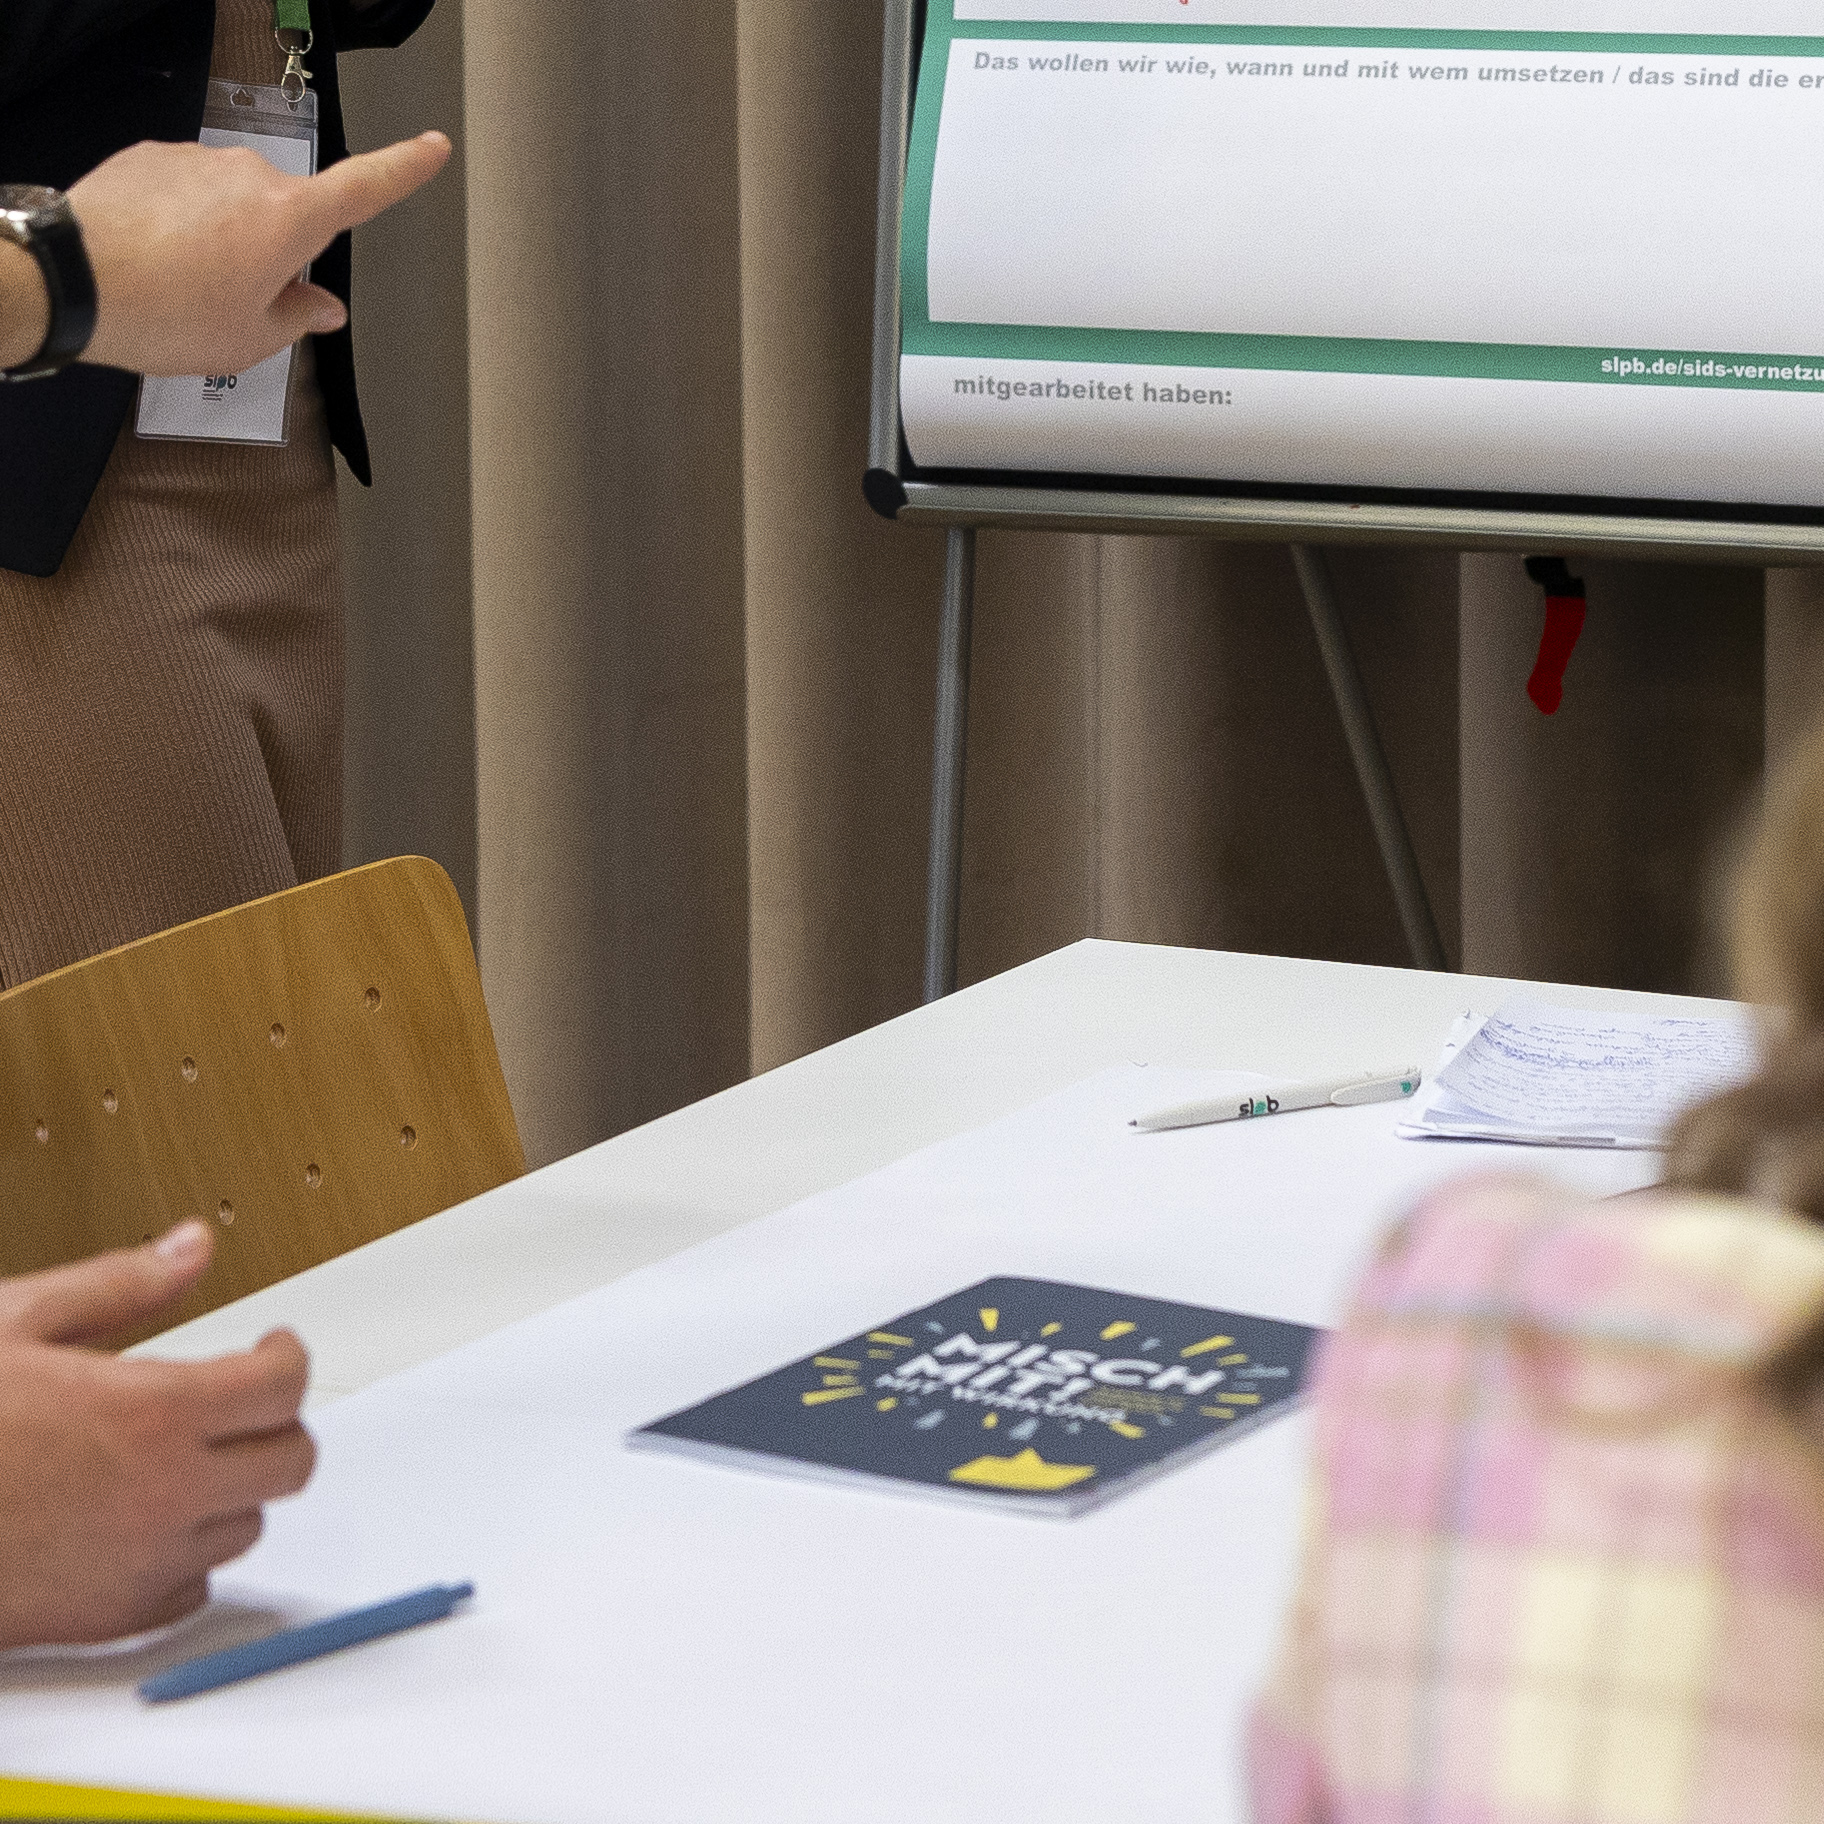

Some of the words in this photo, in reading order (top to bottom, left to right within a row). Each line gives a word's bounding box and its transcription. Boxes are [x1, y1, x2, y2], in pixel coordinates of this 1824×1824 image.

[974, 52, 1019, 71] Das
[1028, 53, 1110, 73] wollen
[1118, 56, 1158, 74] wir
[1165, 56, 1217, 80] wie,
[1226, 60, 1294, 77] wann
[1302, 59, 1348, 79] und
[1357, 60, 1399, 80] mit
[1408, 64, 1468, 81] wem
[1477, 64, 1604, 85] umsetzen
[1612, 65, 1621, 85] /
[1629, 67, 1675, 86] das
[1683, 68, 1740, 88] sind
[1749, 69, 1790, 90] die
[954, 375, 1133, 401] mitgearbeitet
[1143, 382, 1232, 405] haben:
[932, 1332, 1225, 1395] MISCH
